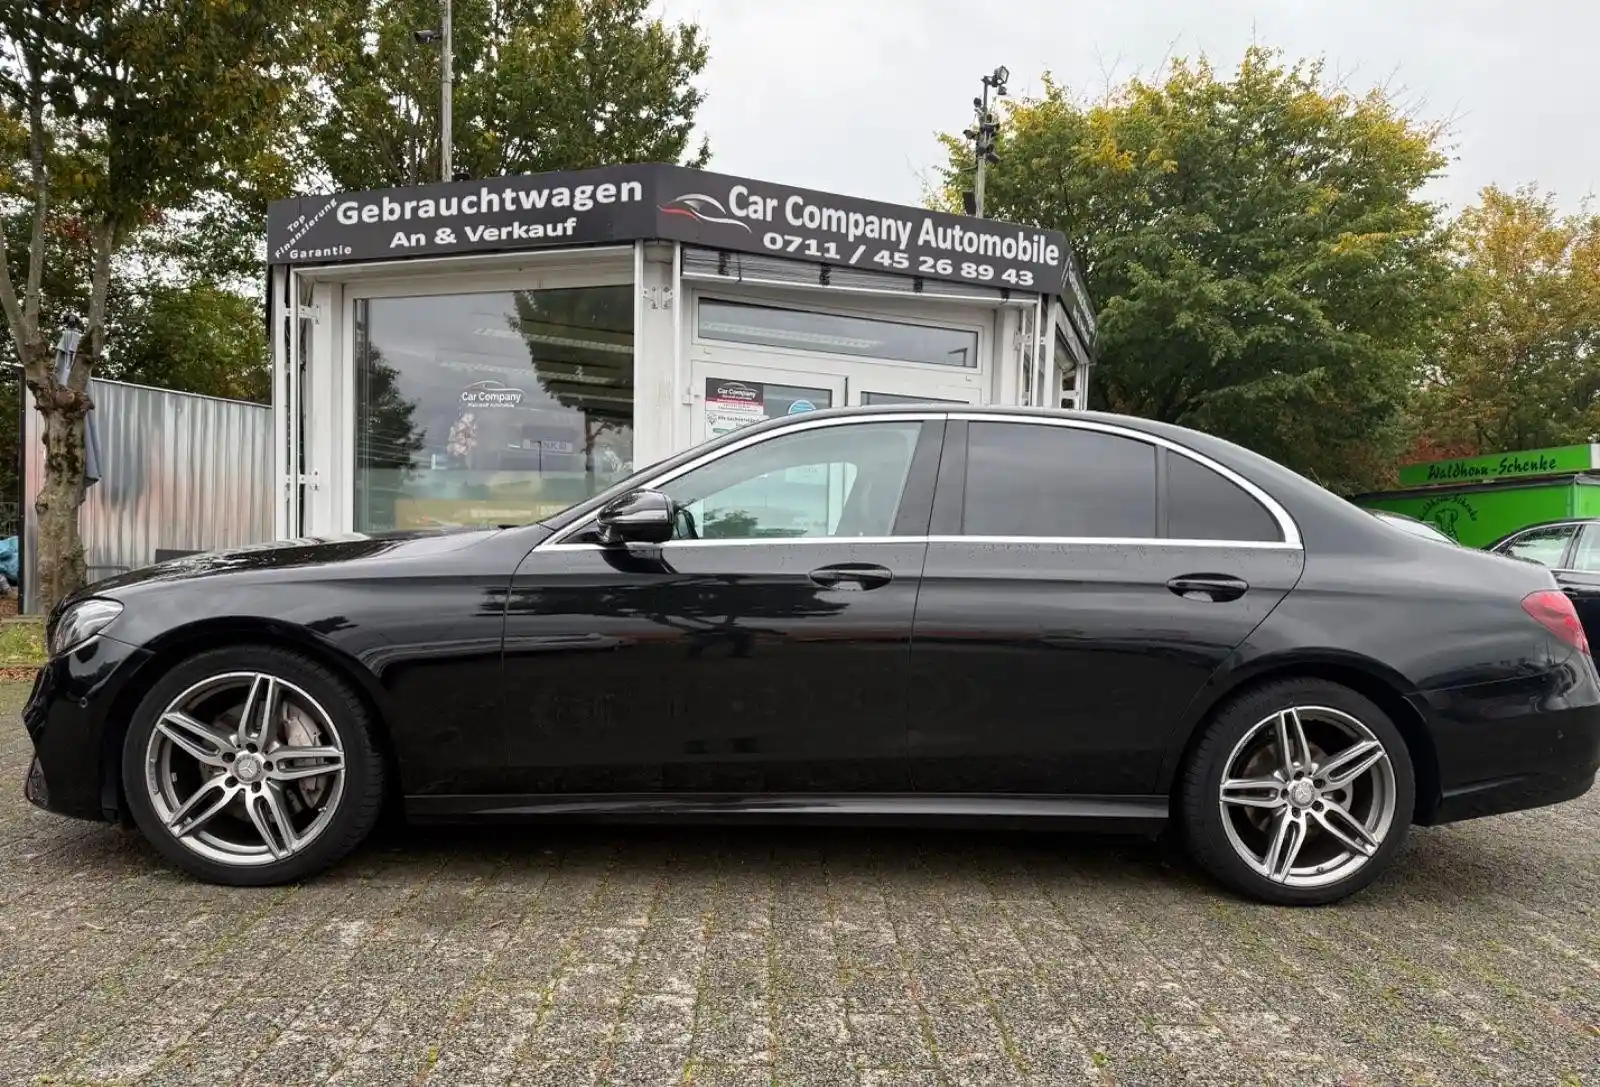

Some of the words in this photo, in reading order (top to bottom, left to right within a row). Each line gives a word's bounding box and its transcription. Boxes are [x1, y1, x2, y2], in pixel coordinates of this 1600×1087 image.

[336, 180, 643, 226] Gebrauchtwagen
[729, 185, 778, 222] Car
[785, 195, 912, 250] Company
[918, 218, 1060, 266] Automobile
[274, 197, 338, 259] Finanzierung
[389, 230, 427, 249] An
[434, 227, 457, 245] &
[464, 217, 578, 243] Verkauf
[289, 244, 353, 260] Garantie
[763, 232, 841, 260] 0711
[849, 244, 867, 264] /
[873, 250, 910, 269] 45
[918, 256, 953, 275] 26
[960, 262, 995, 280] 89
[1001, 268, 1034, 286] 43
[462, 391, 477, 402] Car
[479, 391, 522, 404] Company
